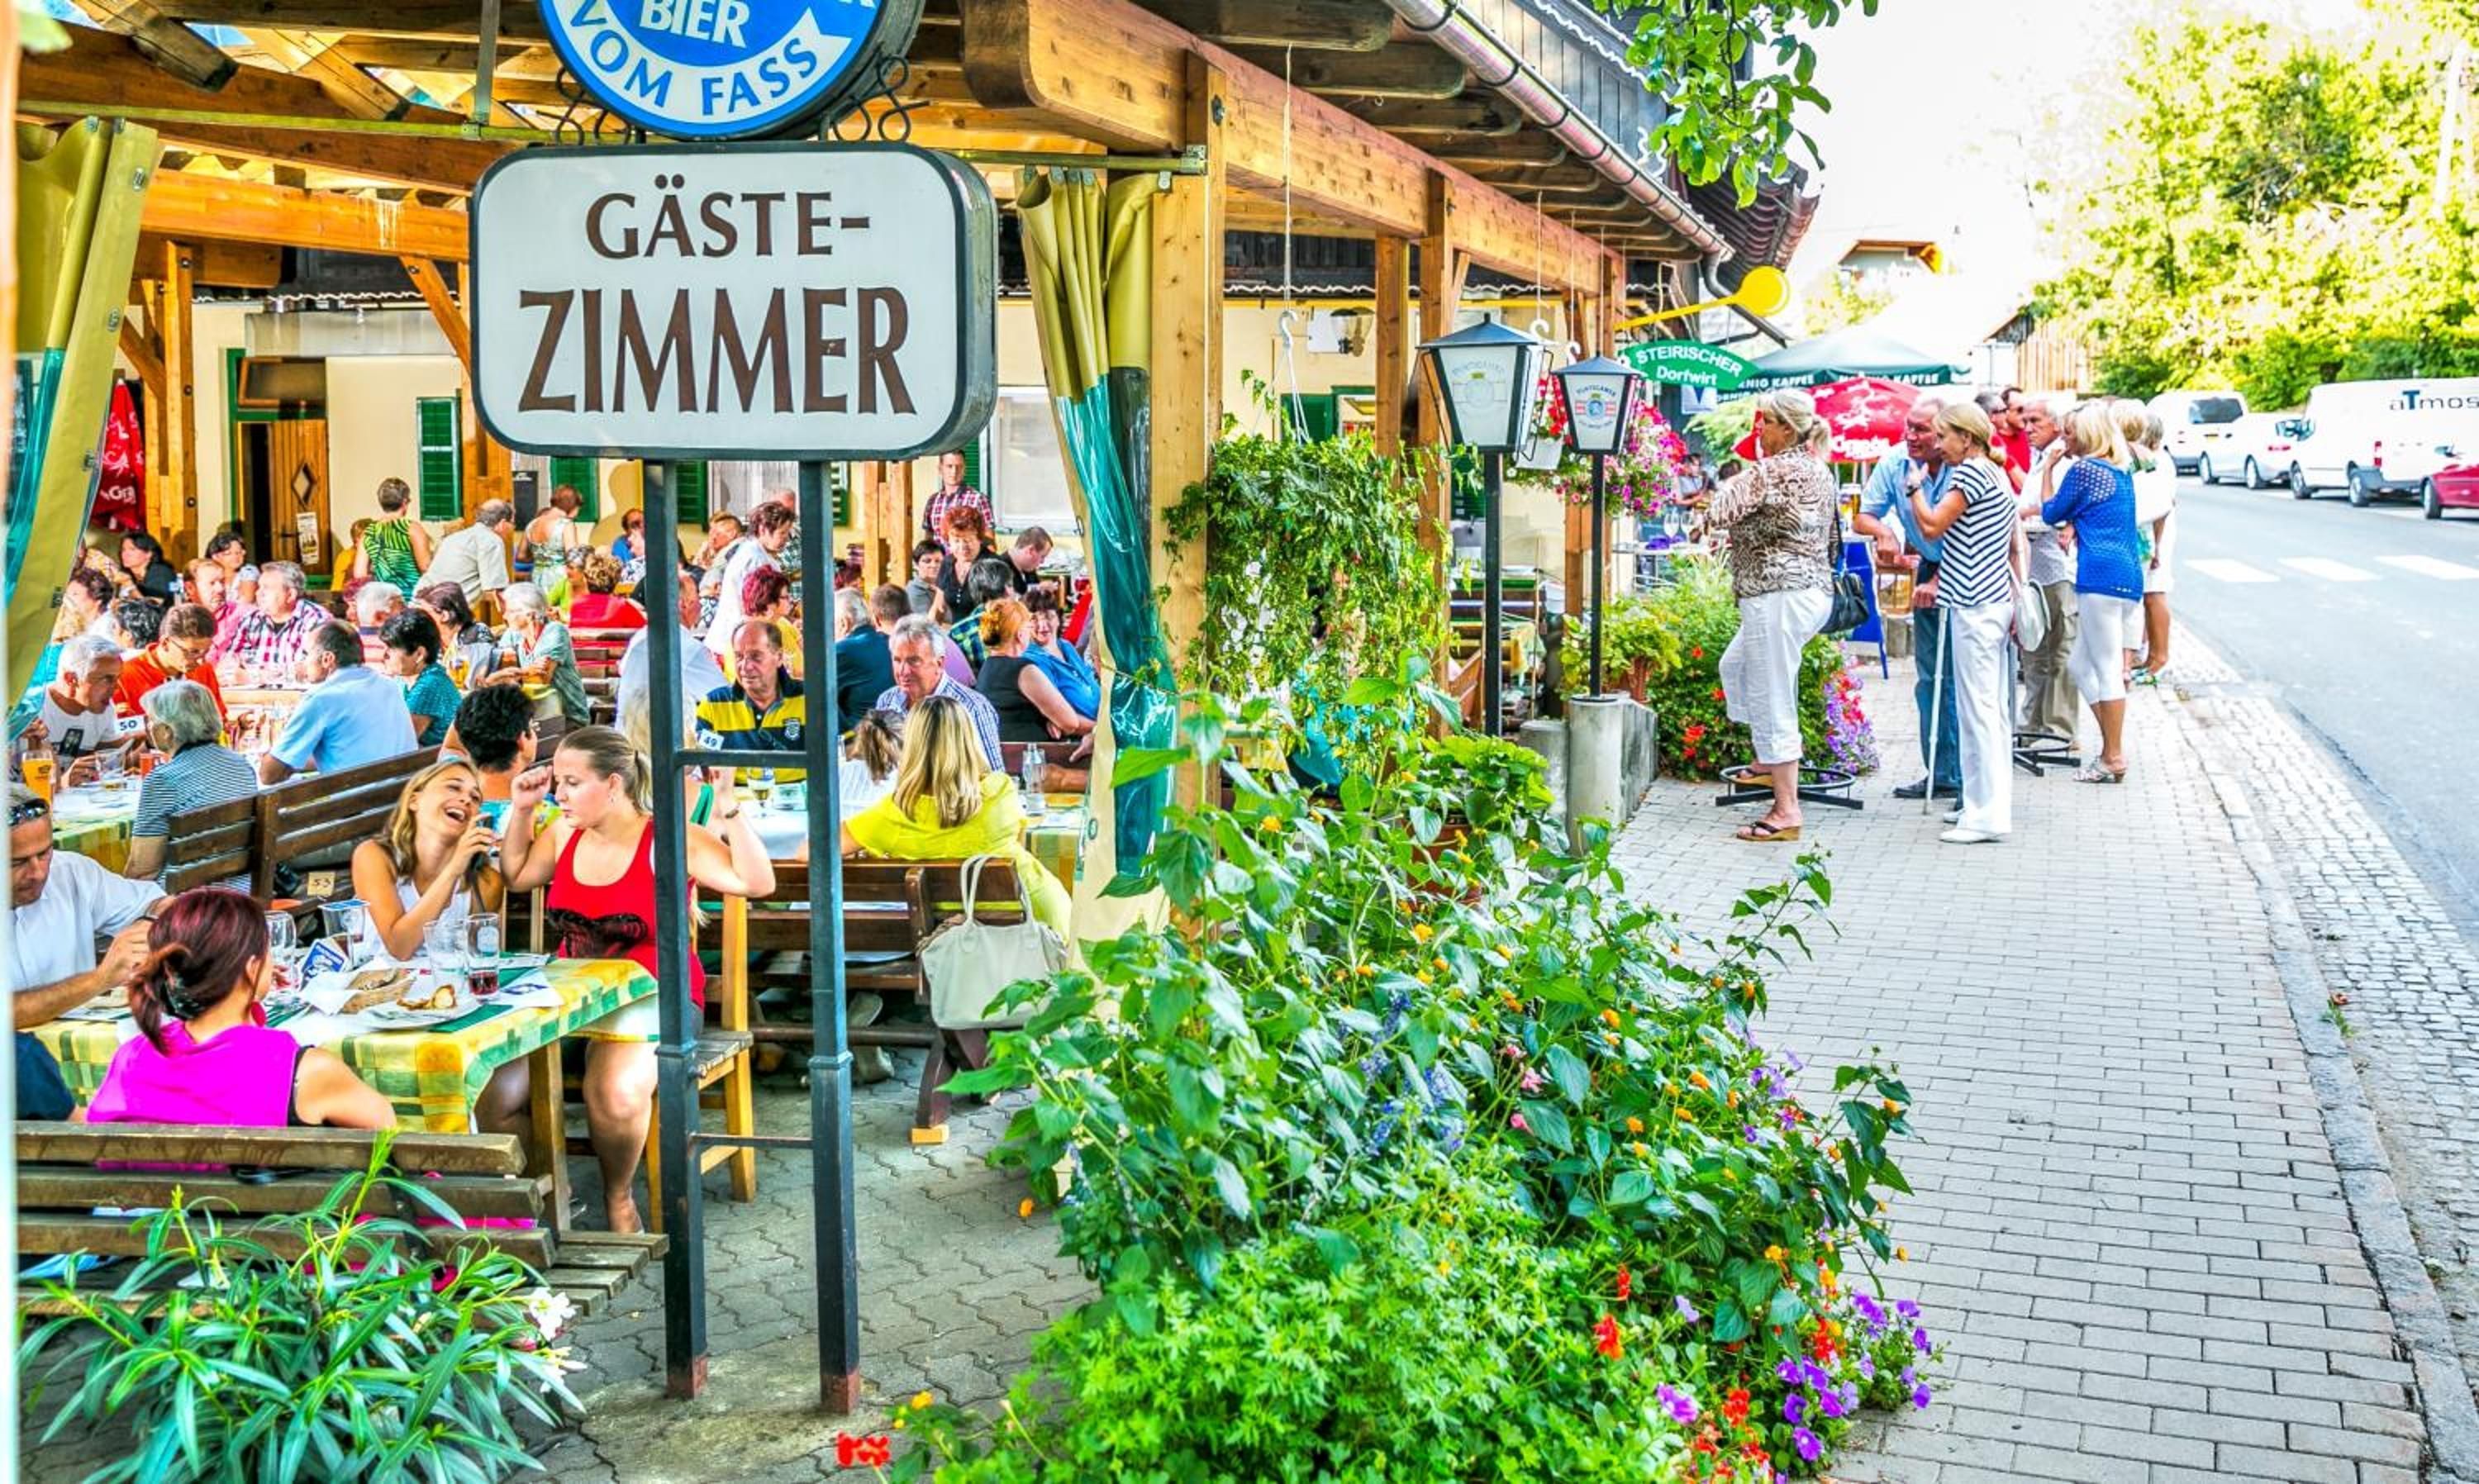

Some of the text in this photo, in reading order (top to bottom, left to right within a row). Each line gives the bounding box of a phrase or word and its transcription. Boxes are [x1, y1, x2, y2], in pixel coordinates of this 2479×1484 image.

[639, 0, 750, 48] BIER
[570, 0, 817, 116] VOM FASS
[585, 174, 870, 259] GÄSTE-
[518, 287, 918, 415] ZIMMER
[1636, 345, 1743, 378] STEIRISCHER
[1657, 366, 1717, 386] Dorfwirt
